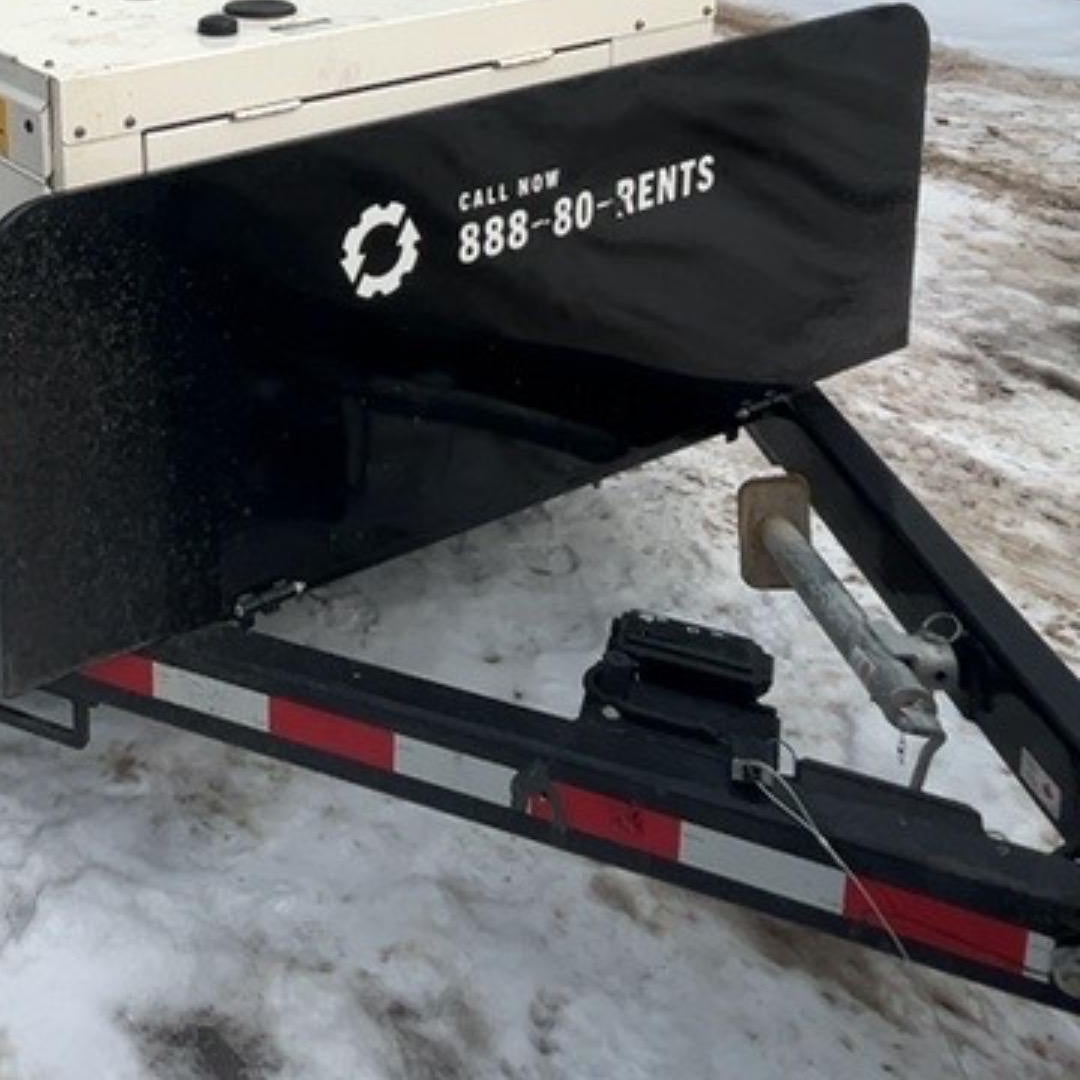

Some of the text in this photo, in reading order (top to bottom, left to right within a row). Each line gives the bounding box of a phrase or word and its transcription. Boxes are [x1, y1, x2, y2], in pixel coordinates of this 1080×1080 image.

[458, 168, 561, 212] CALL NOW
[458, 154, 716, 263] 888-80-RENTS
